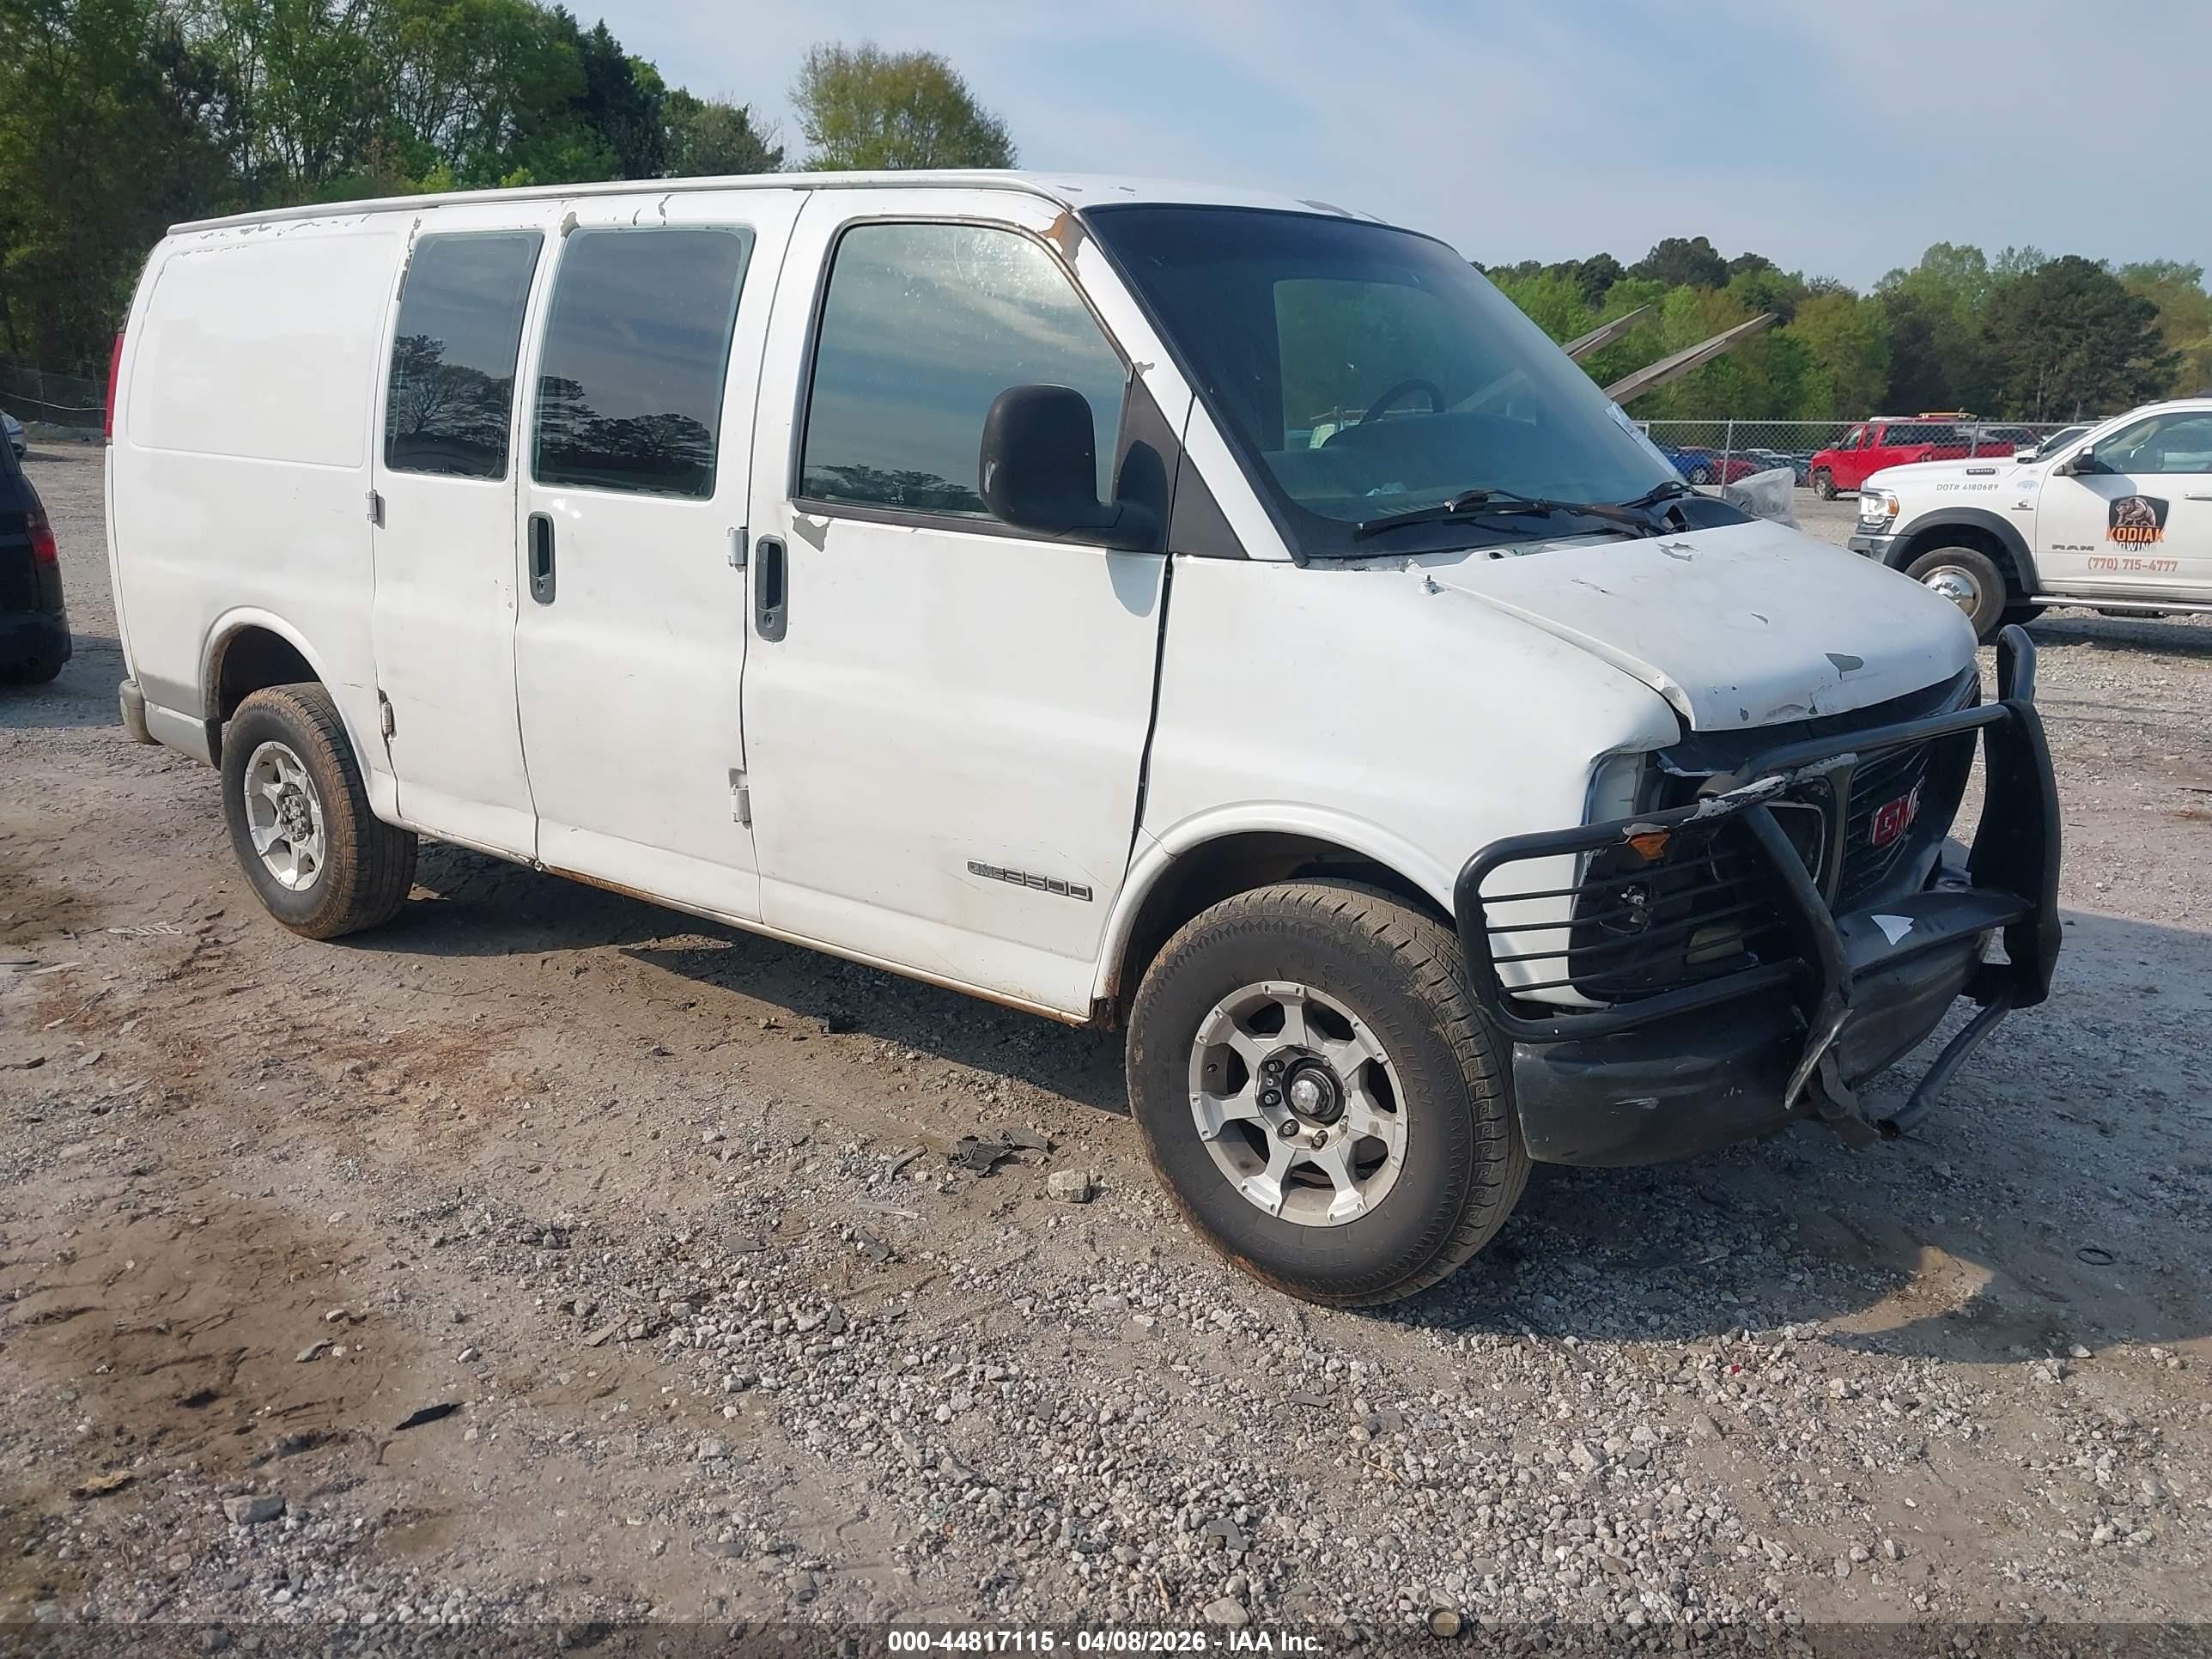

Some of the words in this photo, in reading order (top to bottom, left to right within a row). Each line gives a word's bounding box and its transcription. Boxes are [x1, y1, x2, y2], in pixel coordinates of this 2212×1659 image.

[2106, 526, 2165, 543] KODIAK
[2087, 556, 2118, 570] (770)
[2122, 559, 2179, 572] 715-4777
